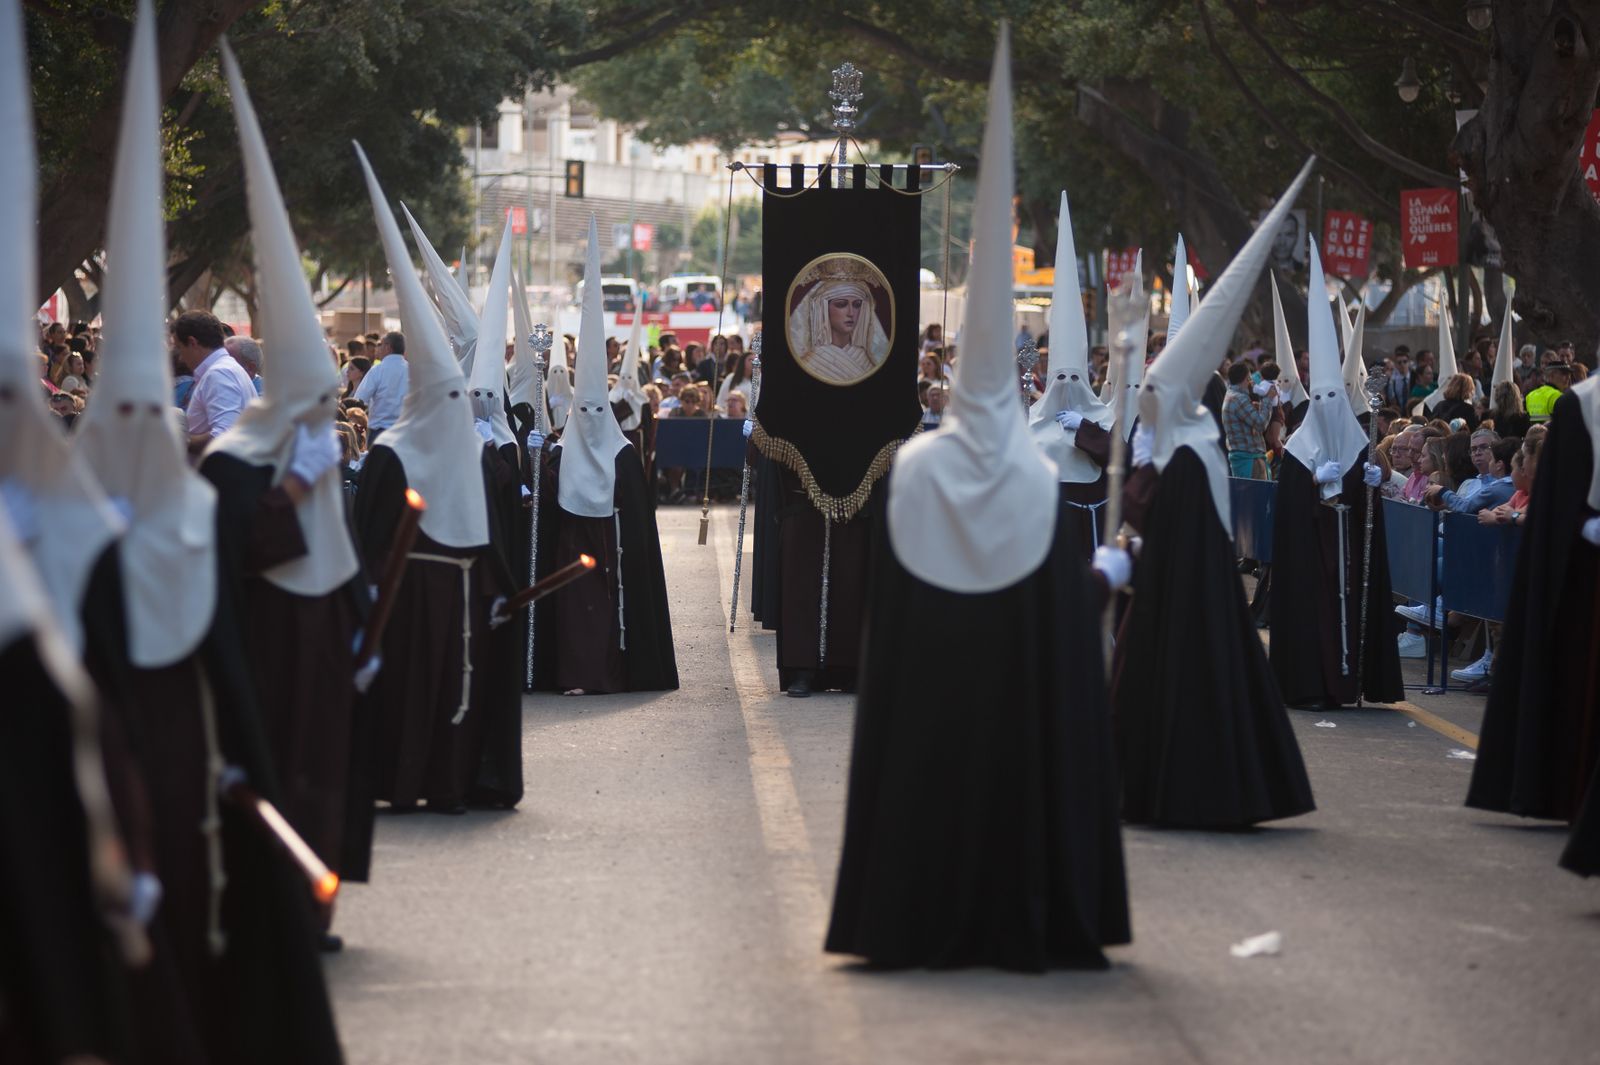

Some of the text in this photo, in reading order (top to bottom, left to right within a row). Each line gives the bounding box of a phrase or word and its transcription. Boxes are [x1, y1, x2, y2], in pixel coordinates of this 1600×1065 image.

[1409, 197, 1422, 207] LA
[1409, 203, 1450, 216] ESPAÑA
[1409, 215, 1431, 226] QUE
[1409, 222, 1453, 234] QUIERES
[1327, 245, 1365, 259] PASE
